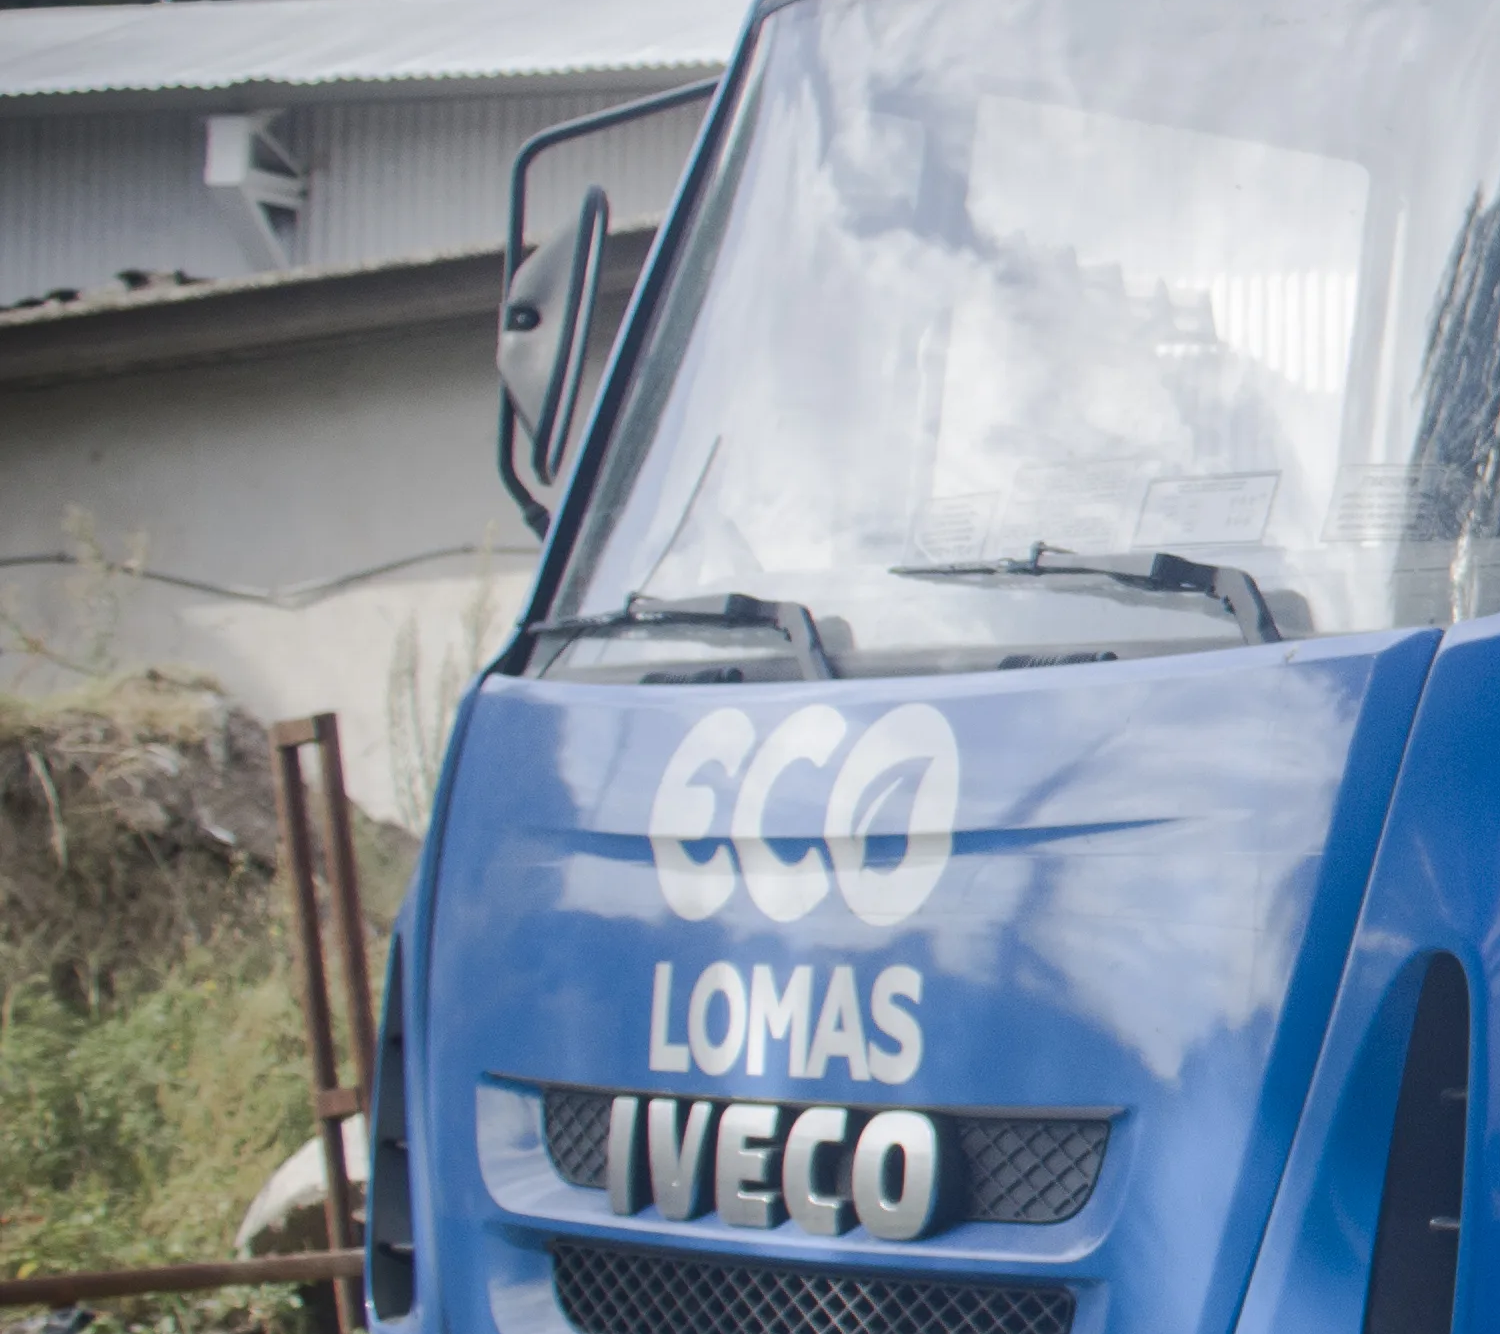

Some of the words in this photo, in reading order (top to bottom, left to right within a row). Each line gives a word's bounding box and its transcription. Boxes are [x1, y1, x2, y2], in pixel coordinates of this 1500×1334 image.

[648, 703, 960, 926] ECO
[648, 961, 923, 1085] LOMAS
[606, 1096, 940, 1241] IVECO
